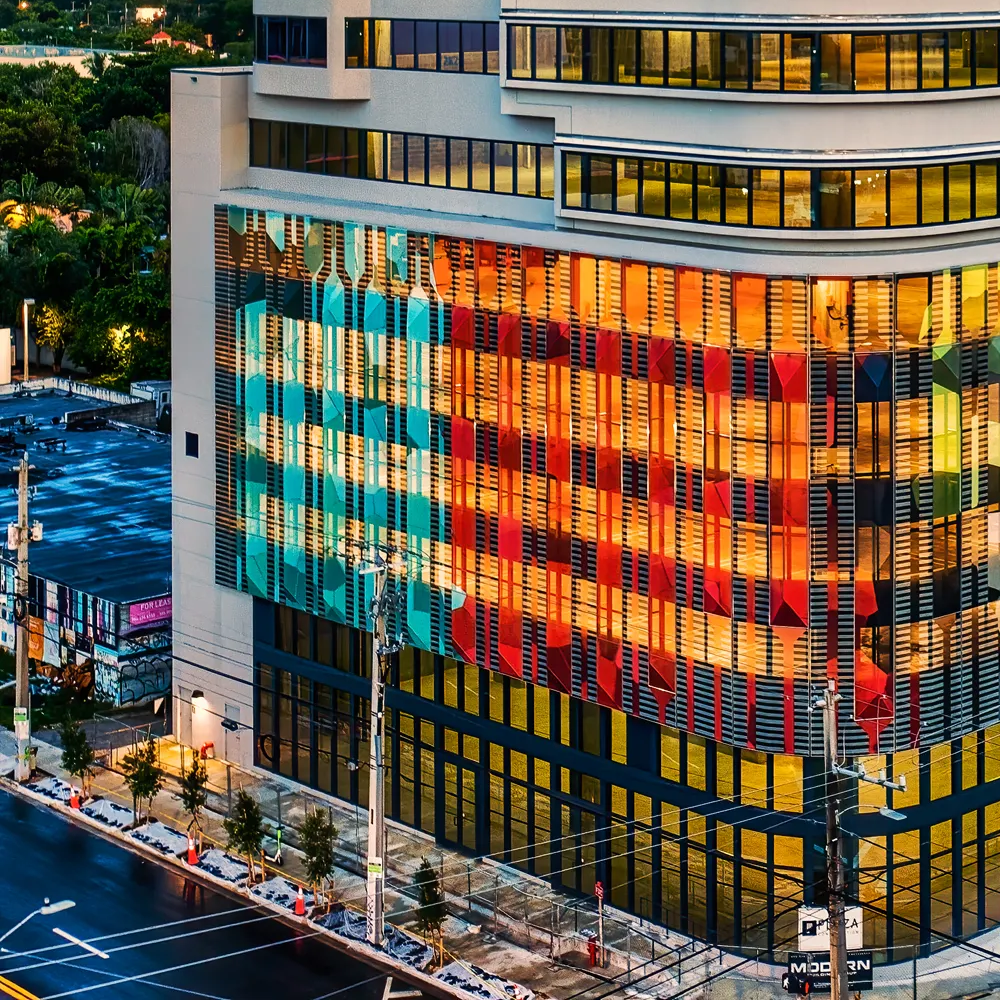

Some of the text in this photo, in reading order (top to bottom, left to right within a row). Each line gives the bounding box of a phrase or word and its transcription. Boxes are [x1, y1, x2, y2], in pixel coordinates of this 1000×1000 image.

[141, 602, 154, 611] FOR
[818, 918, 859, 931] PLZA
[790, 959, 870, 973] MODRN
